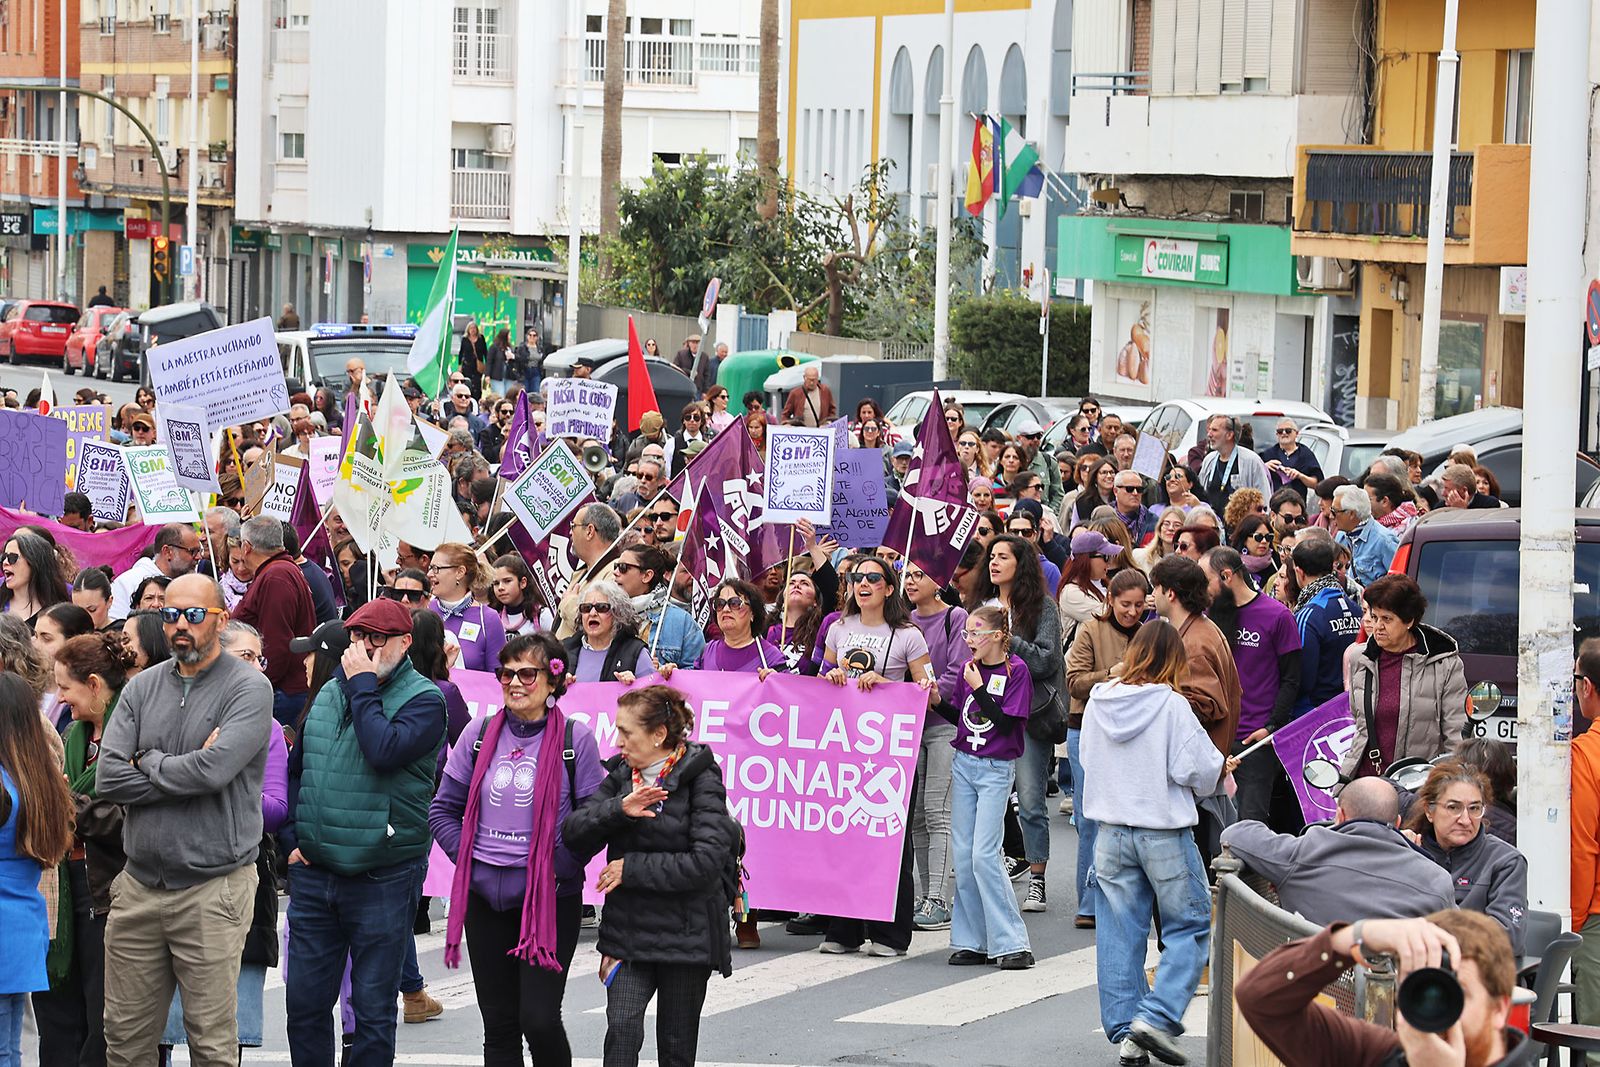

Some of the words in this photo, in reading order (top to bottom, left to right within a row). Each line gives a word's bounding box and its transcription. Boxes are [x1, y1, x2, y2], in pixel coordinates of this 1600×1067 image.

[1, 215, 21, 223] TINTE
[3, 222, 20, 233] 5€
[1157, 252, 1193, 273] COVIRAN
[174, 347, 216, 368] MAESTRA
[553, 387, 575, 405] HASTA
[578, 389, 588, 406] EL
[174, 430, 191, 441] 8M
[782, 446, 811, 460] 8M
[90, 457, 116, 473] 8M
[139, 458, 165, 474] 8M
[549, 462, 575, 488] 8M
[274, 482, 296, 496] NO
[532, 474, 564, 509] LEVANTAOS
[537, 471, 568, 504] ANDALUZAS
[838, 481, 852, 490] TE
[282, 496, 292, 504] LA
[857, 519, 876, 530] DE
[1329, 616, 1361, 632] DECAN
[748, 702, 916, 758] CLASE
[726, 796, 853, 836] MUNDO
[850, 806, 904, 838] PCE
